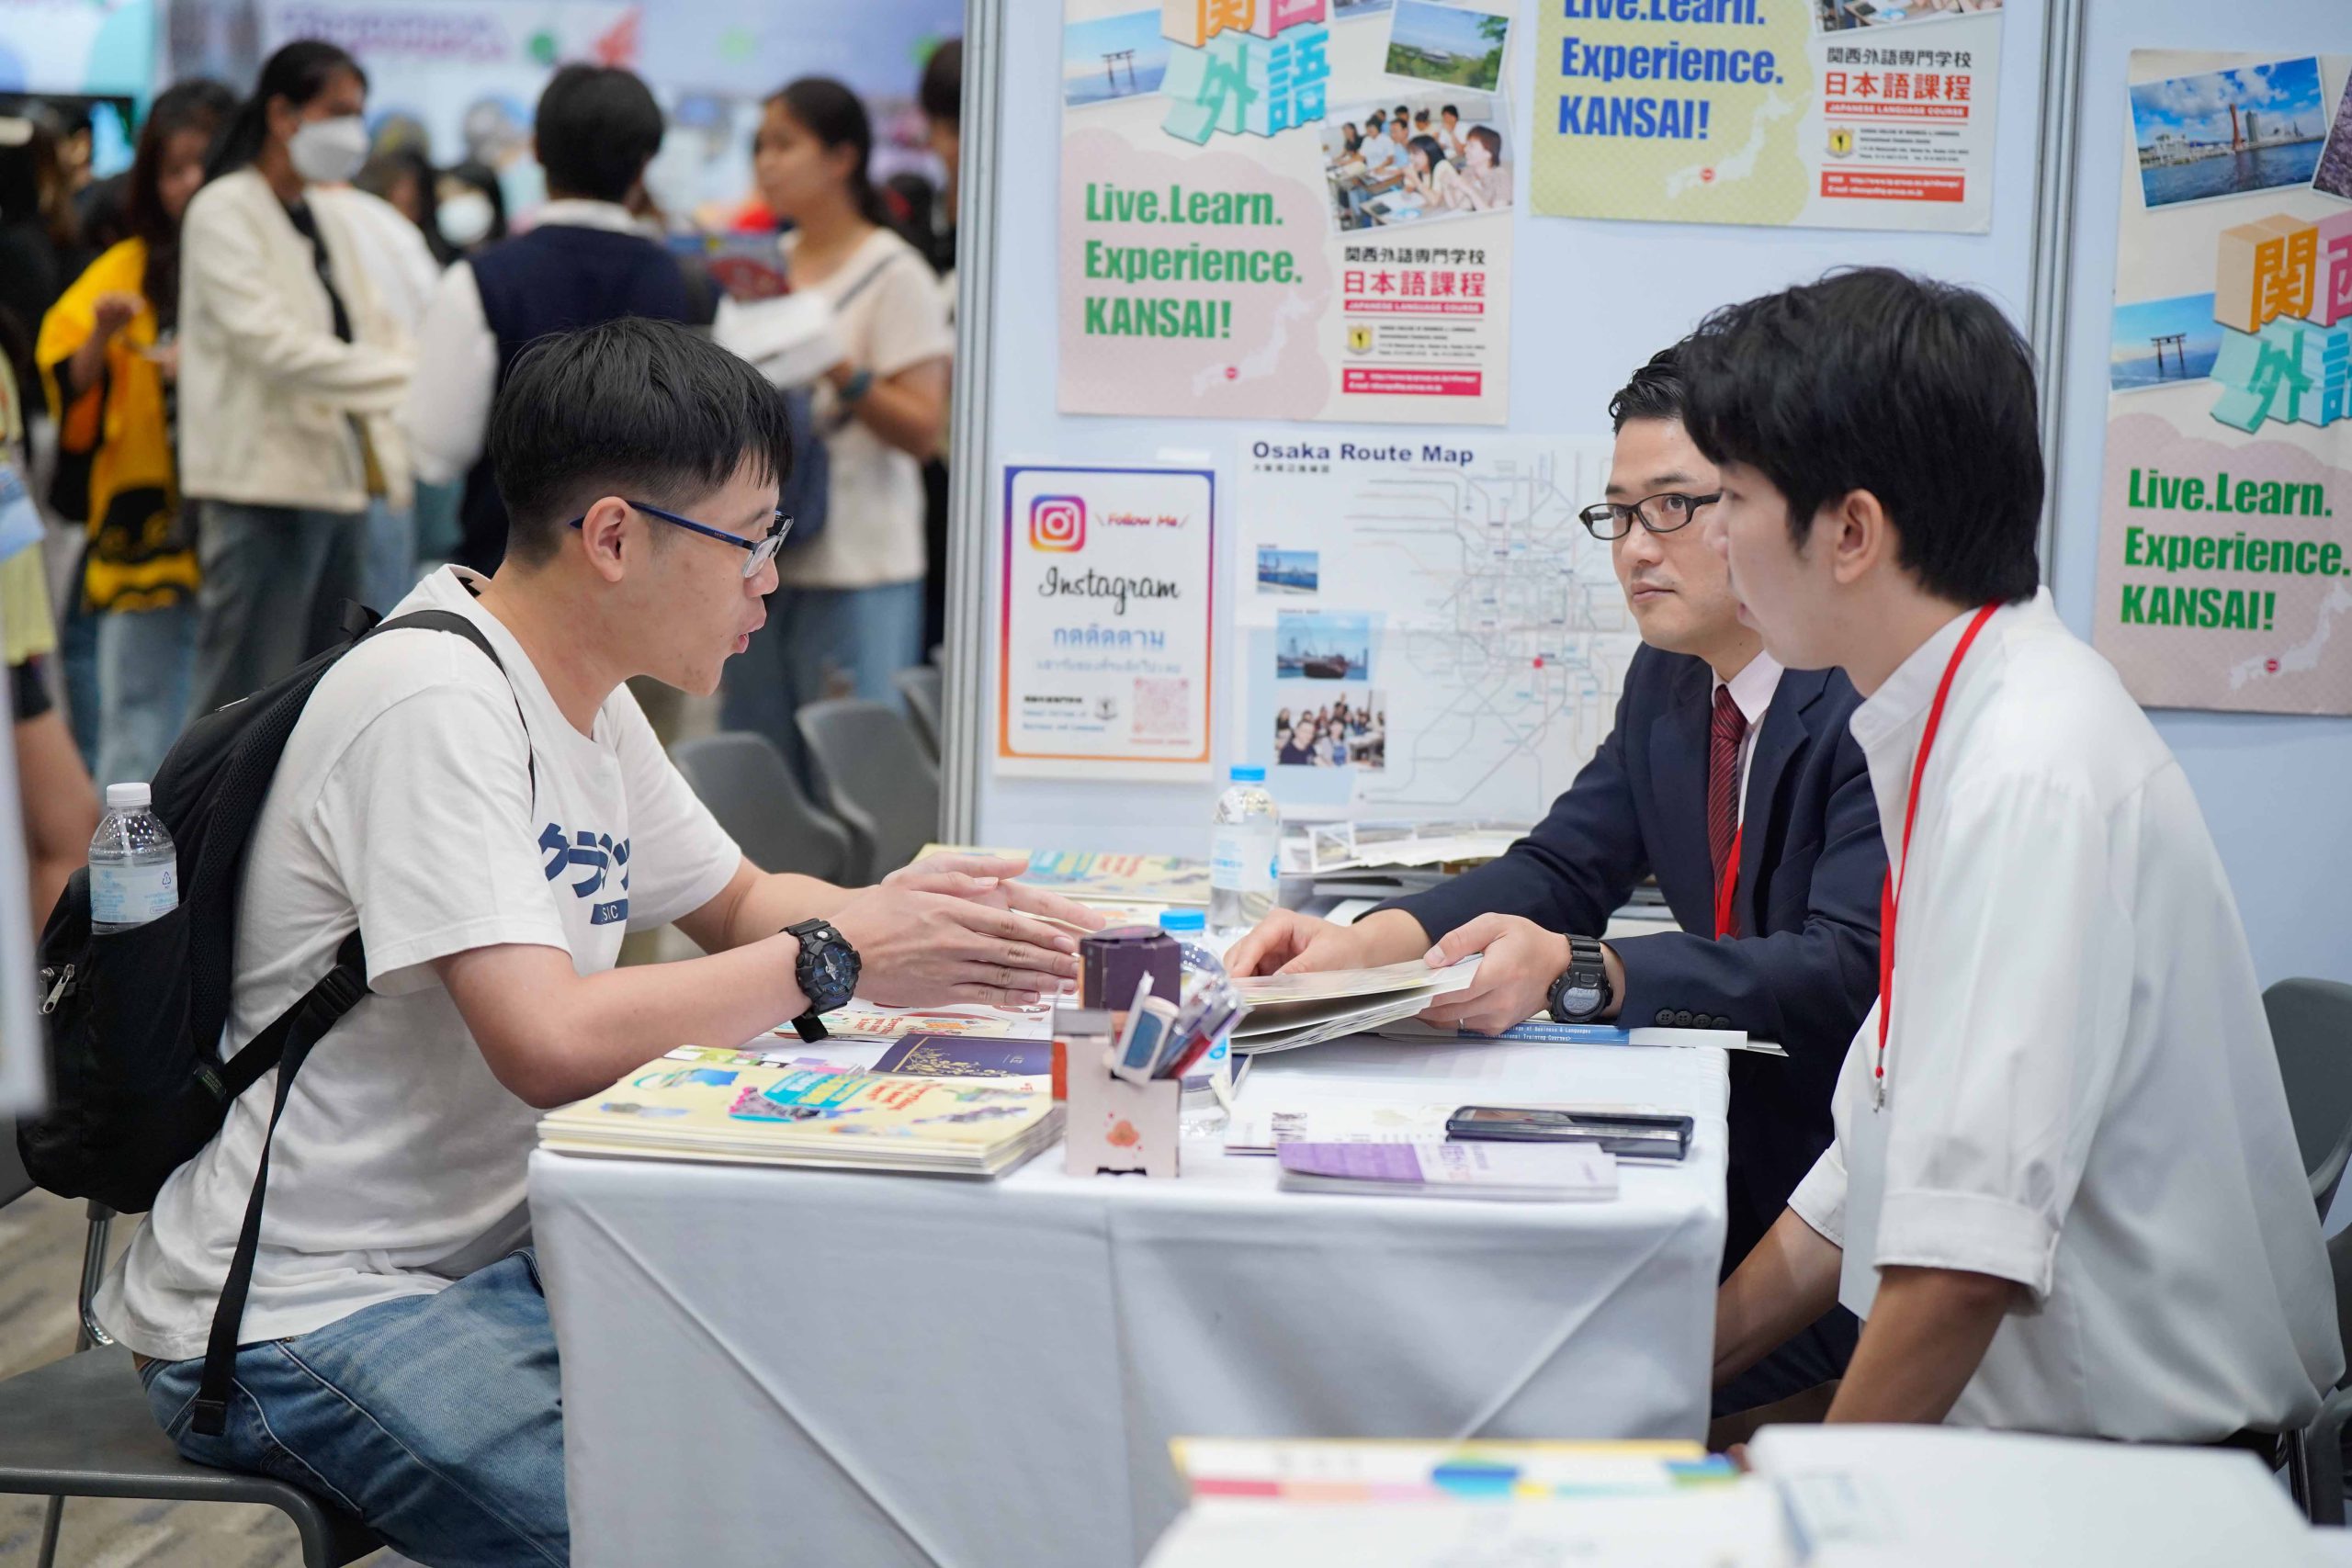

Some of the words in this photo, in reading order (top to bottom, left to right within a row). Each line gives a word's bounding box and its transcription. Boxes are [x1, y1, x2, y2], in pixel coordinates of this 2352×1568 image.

[1561, 36, 1784, 85] Experience.
[1826, 47, 1973, 68] 関西外語専門学校
[1185, 27, 1330, 145] 外語
[1825, 71, 1972, 101] 日本語課程
[1558, 95, 1711, 140] KANSAI!
[1085, 183, 1283, 225] Live.Learn.
[1085, 240, 1303, 284] Experience.
[1344, 246, 1487, 265] 関西外語専門学校
[1343, 270, 1486, 298] 日本語課程
[1085, 296, 1232, 339] KANSAI!
[1252, 441, 1331, 460] Osaka
[1340, 443, 1412, 461] Route
[1421, 446, 1474, 466] Map
[2128, 468, 2333, 517] Live.Learn.
[2124, 526, 2351, 577] Experience.
[1038, 565, 1181, 616] Instagram
[2120, 584, 2277, 631] KANSAI!
